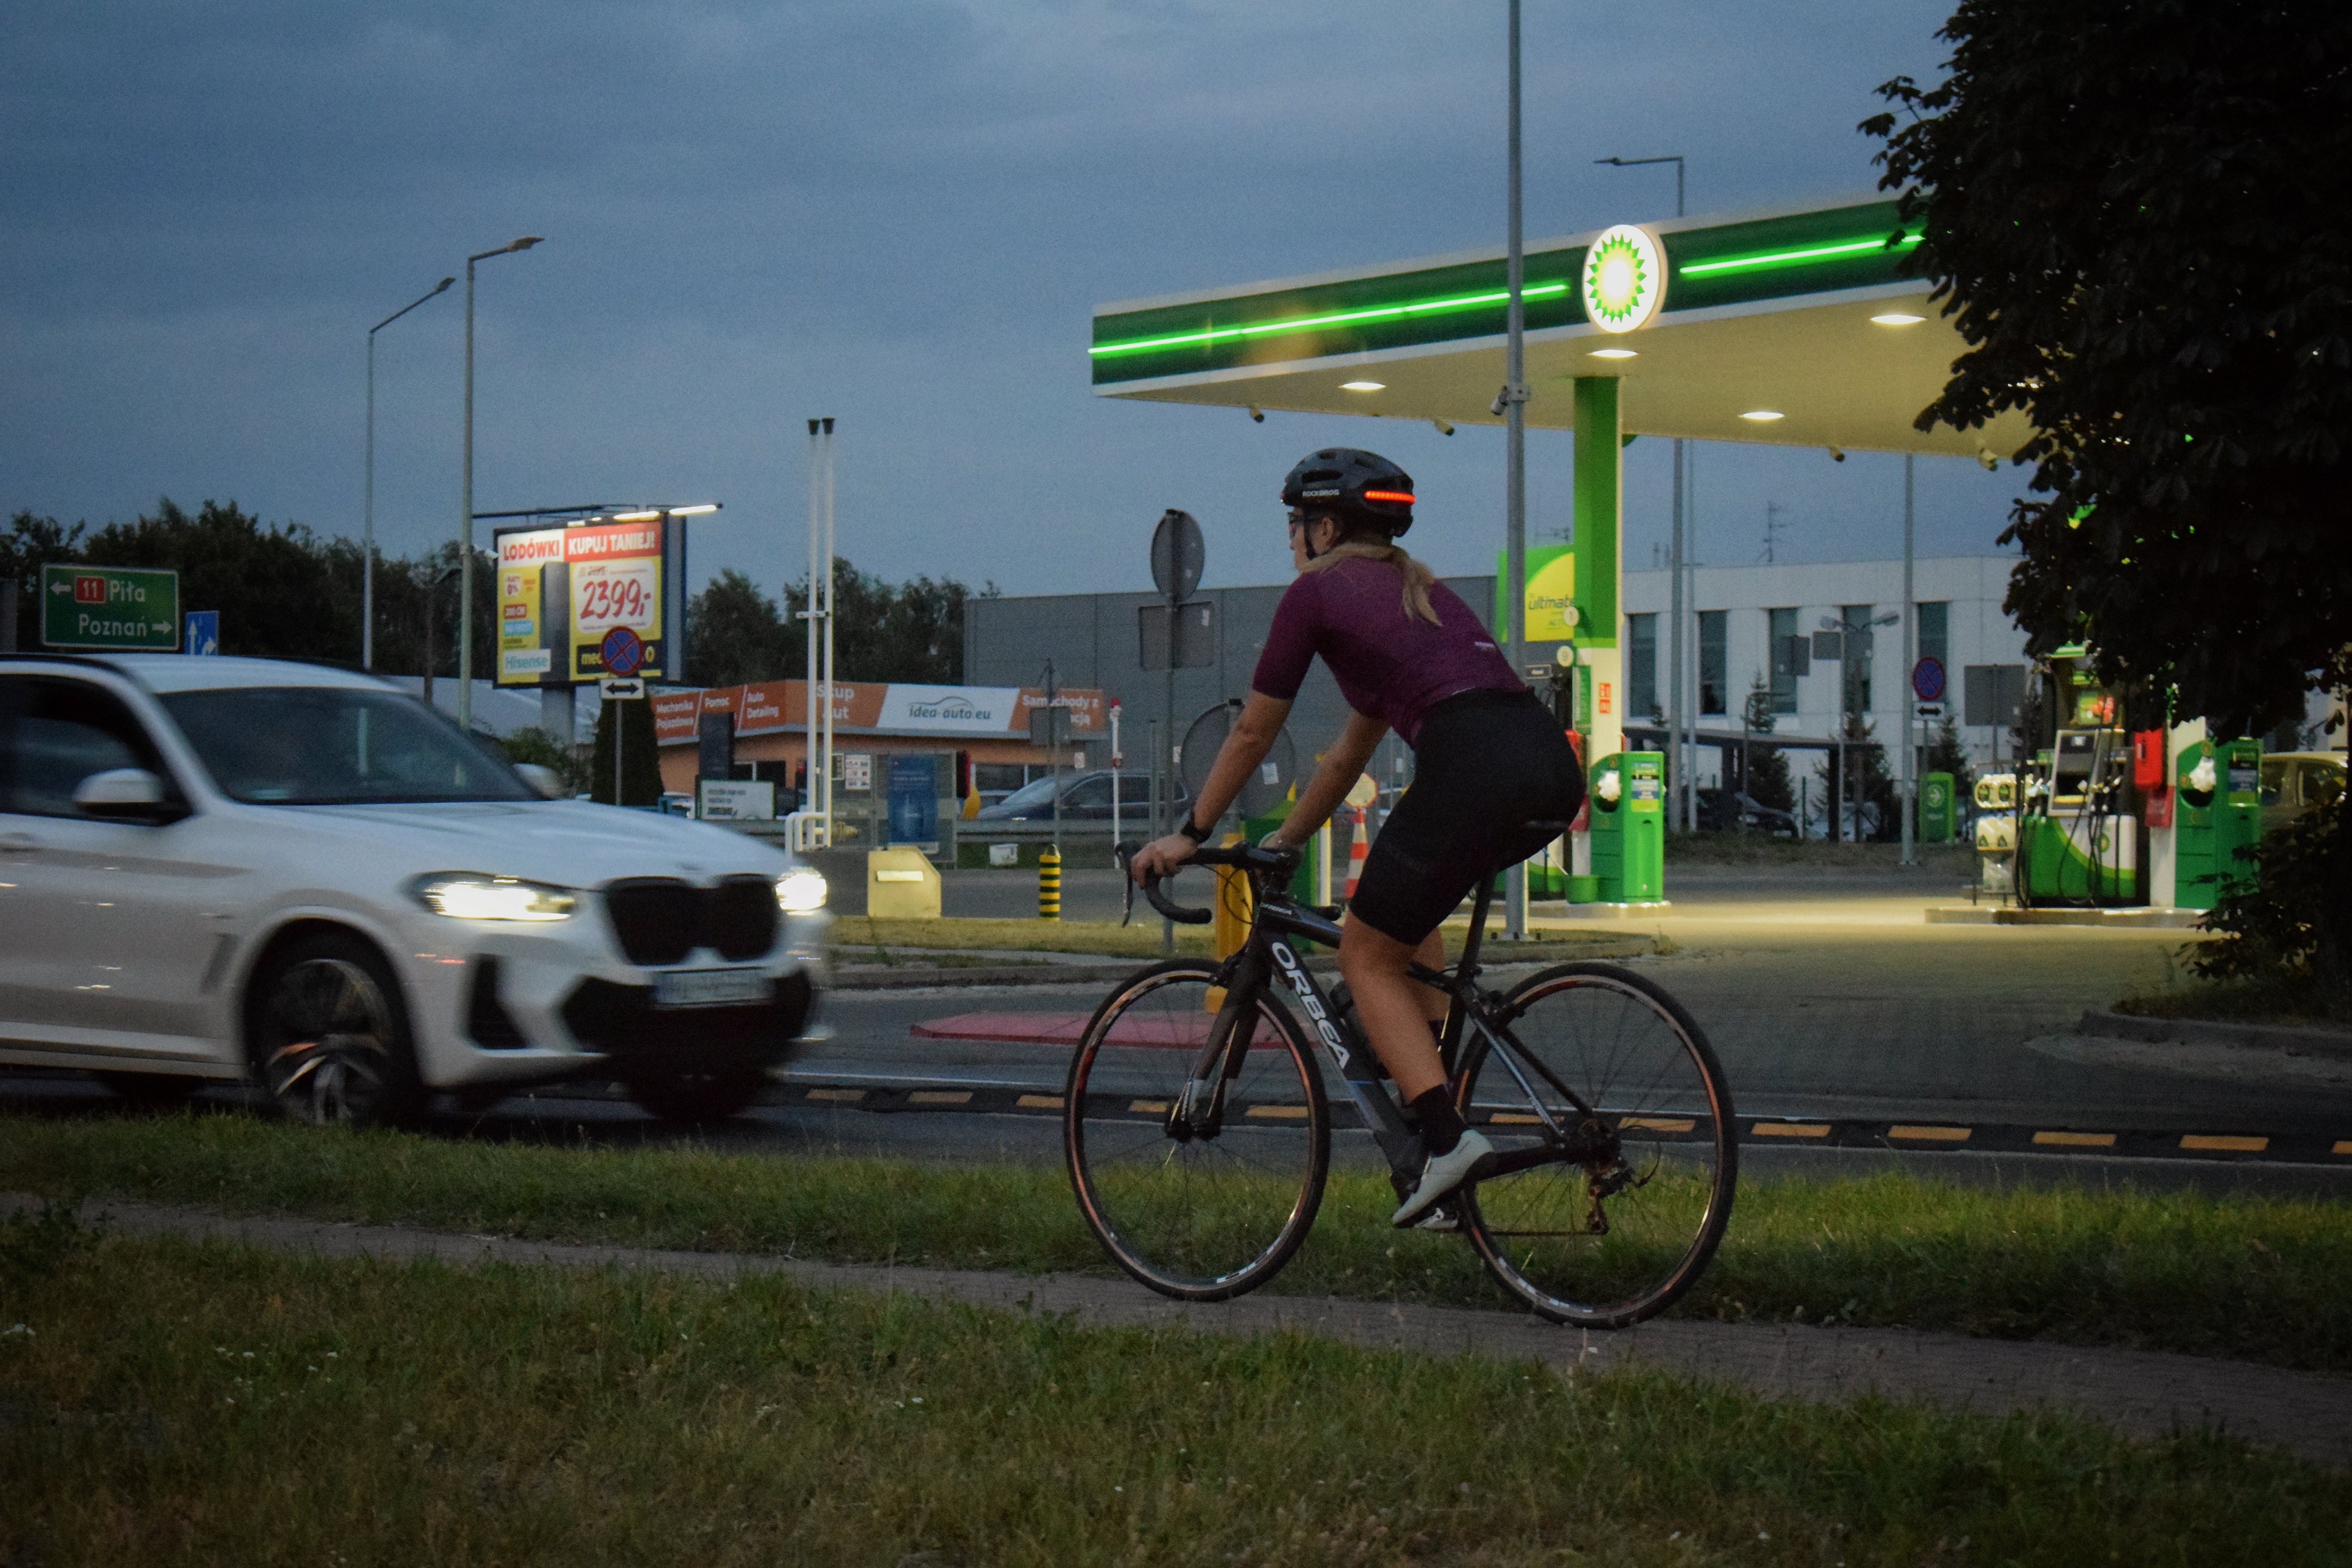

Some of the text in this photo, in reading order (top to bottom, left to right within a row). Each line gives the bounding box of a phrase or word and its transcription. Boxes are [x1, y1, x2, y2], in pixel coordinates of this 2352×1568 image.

[503, 539, 560, 561] LODÓWKI
[568, 531, 655, 555] KUPUJ TANIEJ!
[83, 579, 145, 602] 11 Piła
[79, 613, 147, 637] Poznań
[505, 657, 548, 669] Hisense
[817, 684, 855, 702] Sup
[747, 706, 780, 719] Detailing
[1272, 942, 1350, 1069] ORBEA
